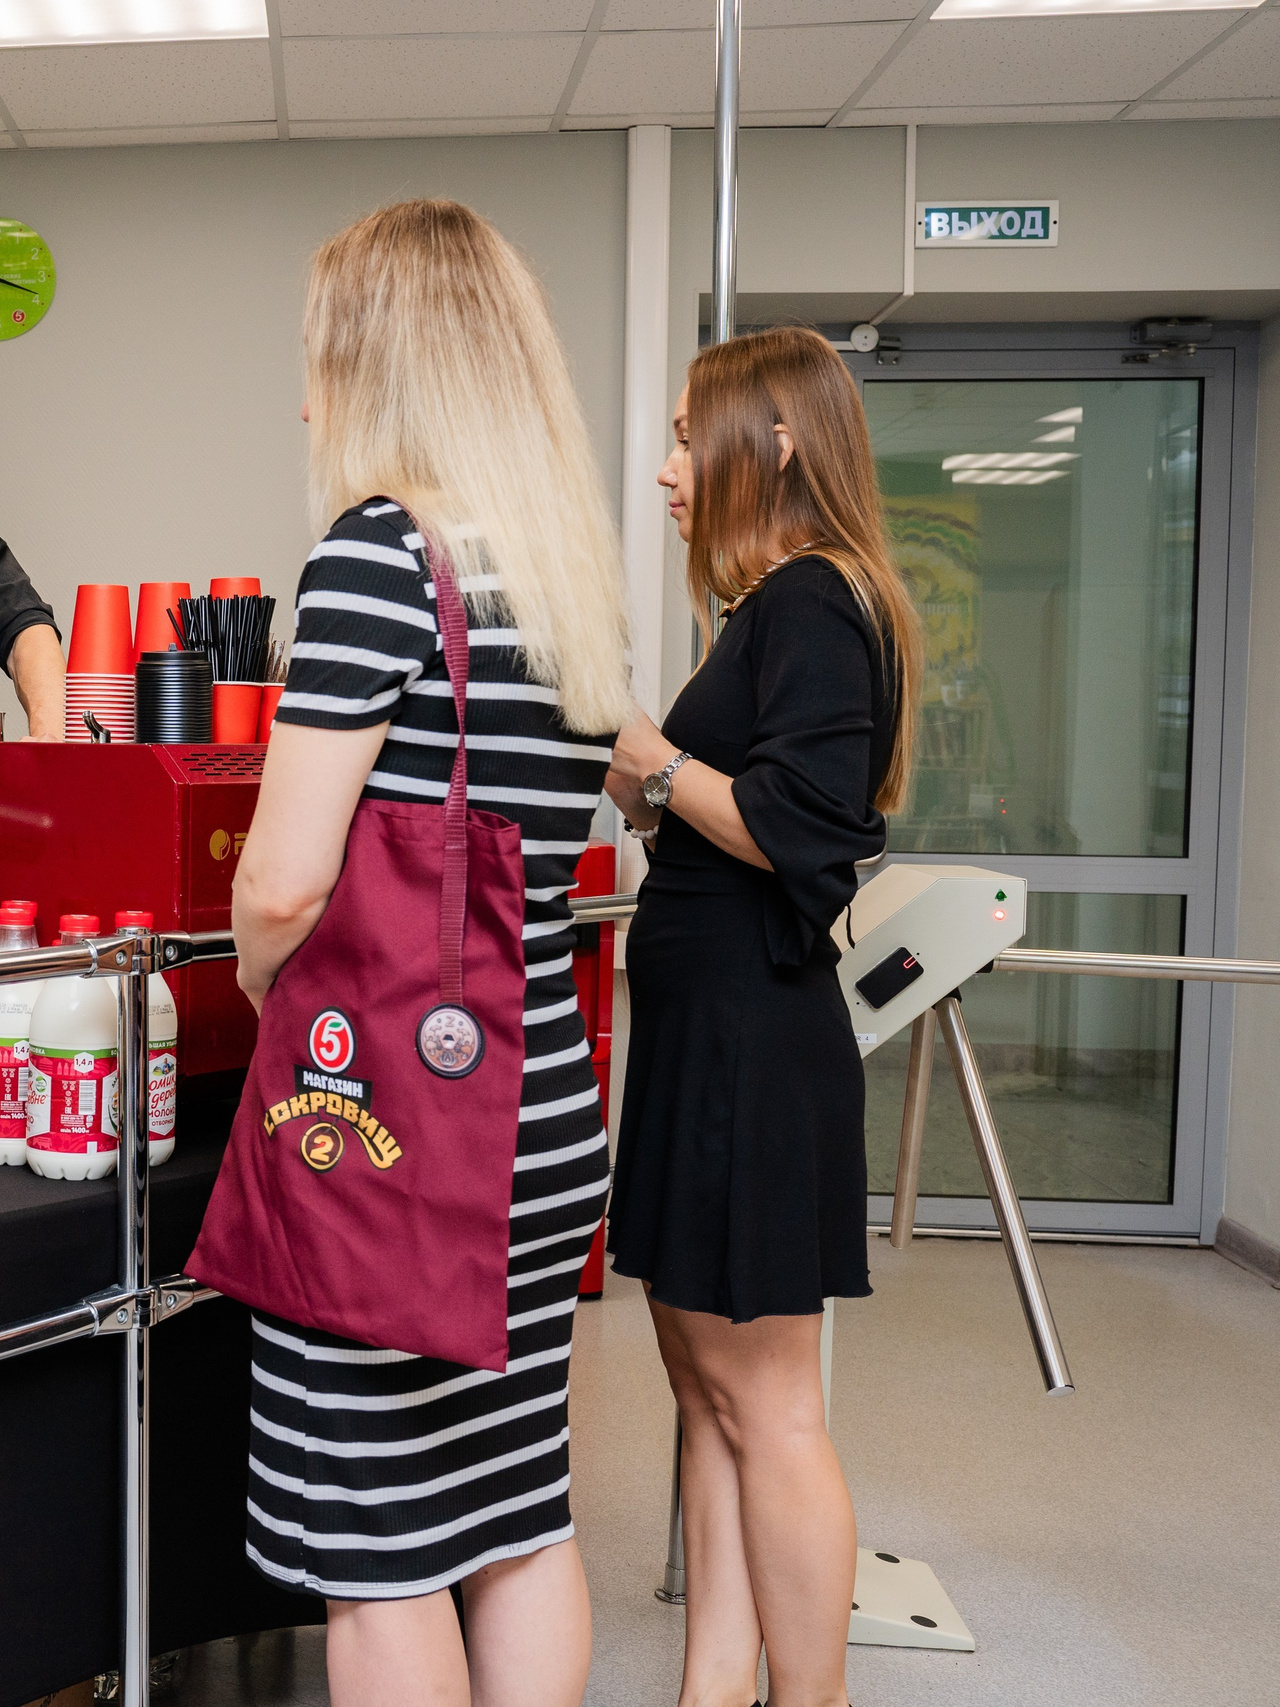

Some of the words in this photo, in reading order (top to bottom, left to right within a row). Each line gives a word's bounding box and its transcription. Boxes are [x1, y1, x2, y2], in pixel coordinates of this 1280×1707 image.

[930, 210, 1044, 238] ВЫХОД
[31, 248, 39, 260] 2
[37, 270, 46, 283] 3
[32, 294, 40, 306] 4
[317, 1016, 348, 1063] 5
[75, 1058, 86, 1067] 1,4
[302, 1070, 364, 1099] МАГАЗИН
[309, 1133, 335, 1163] 2
